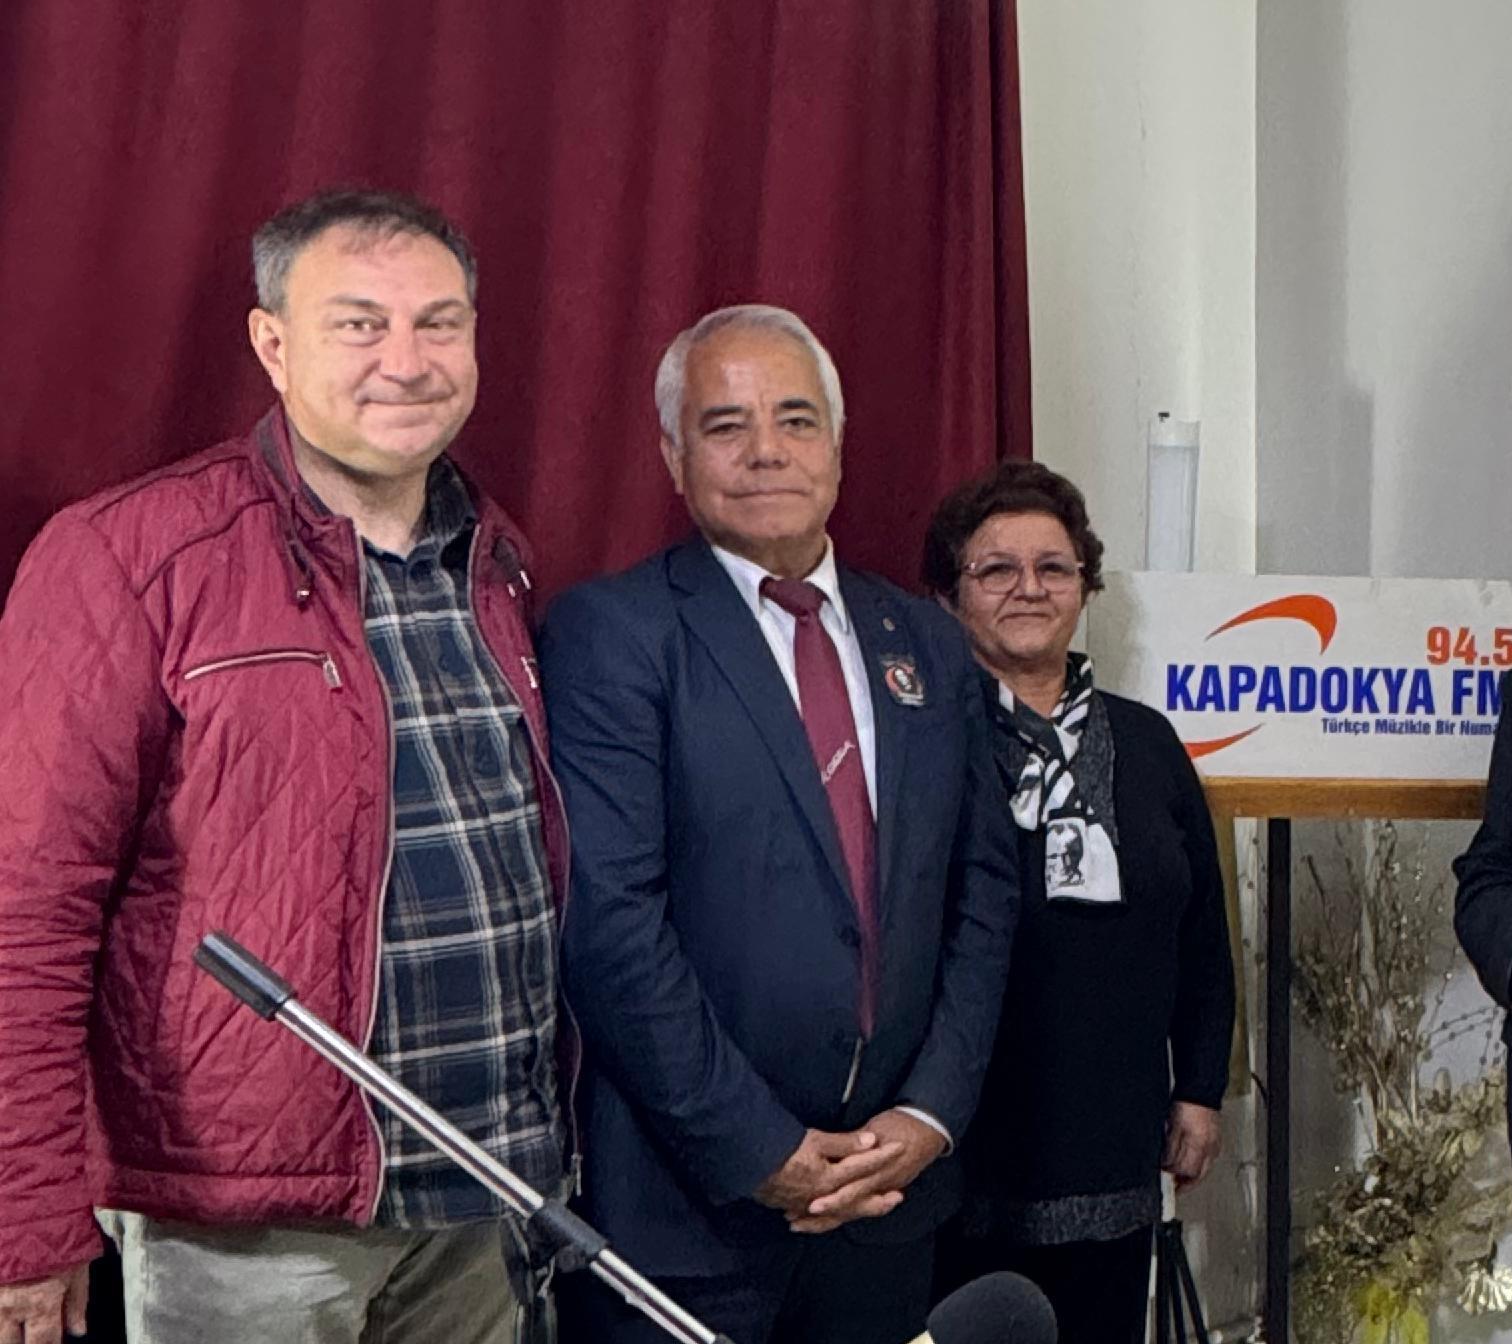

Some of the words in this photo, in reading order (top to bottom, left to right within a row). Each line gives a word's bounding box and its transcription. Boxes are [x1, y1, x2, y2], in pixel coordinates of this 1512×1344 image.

[1166, 663, 1435, 716] KAPADOKYA
[1321, 718, 1370, 736] Türkçe
[1375, 718, 1432, 735] Müzikle
[1435, 720, 1456, 735] Bir
